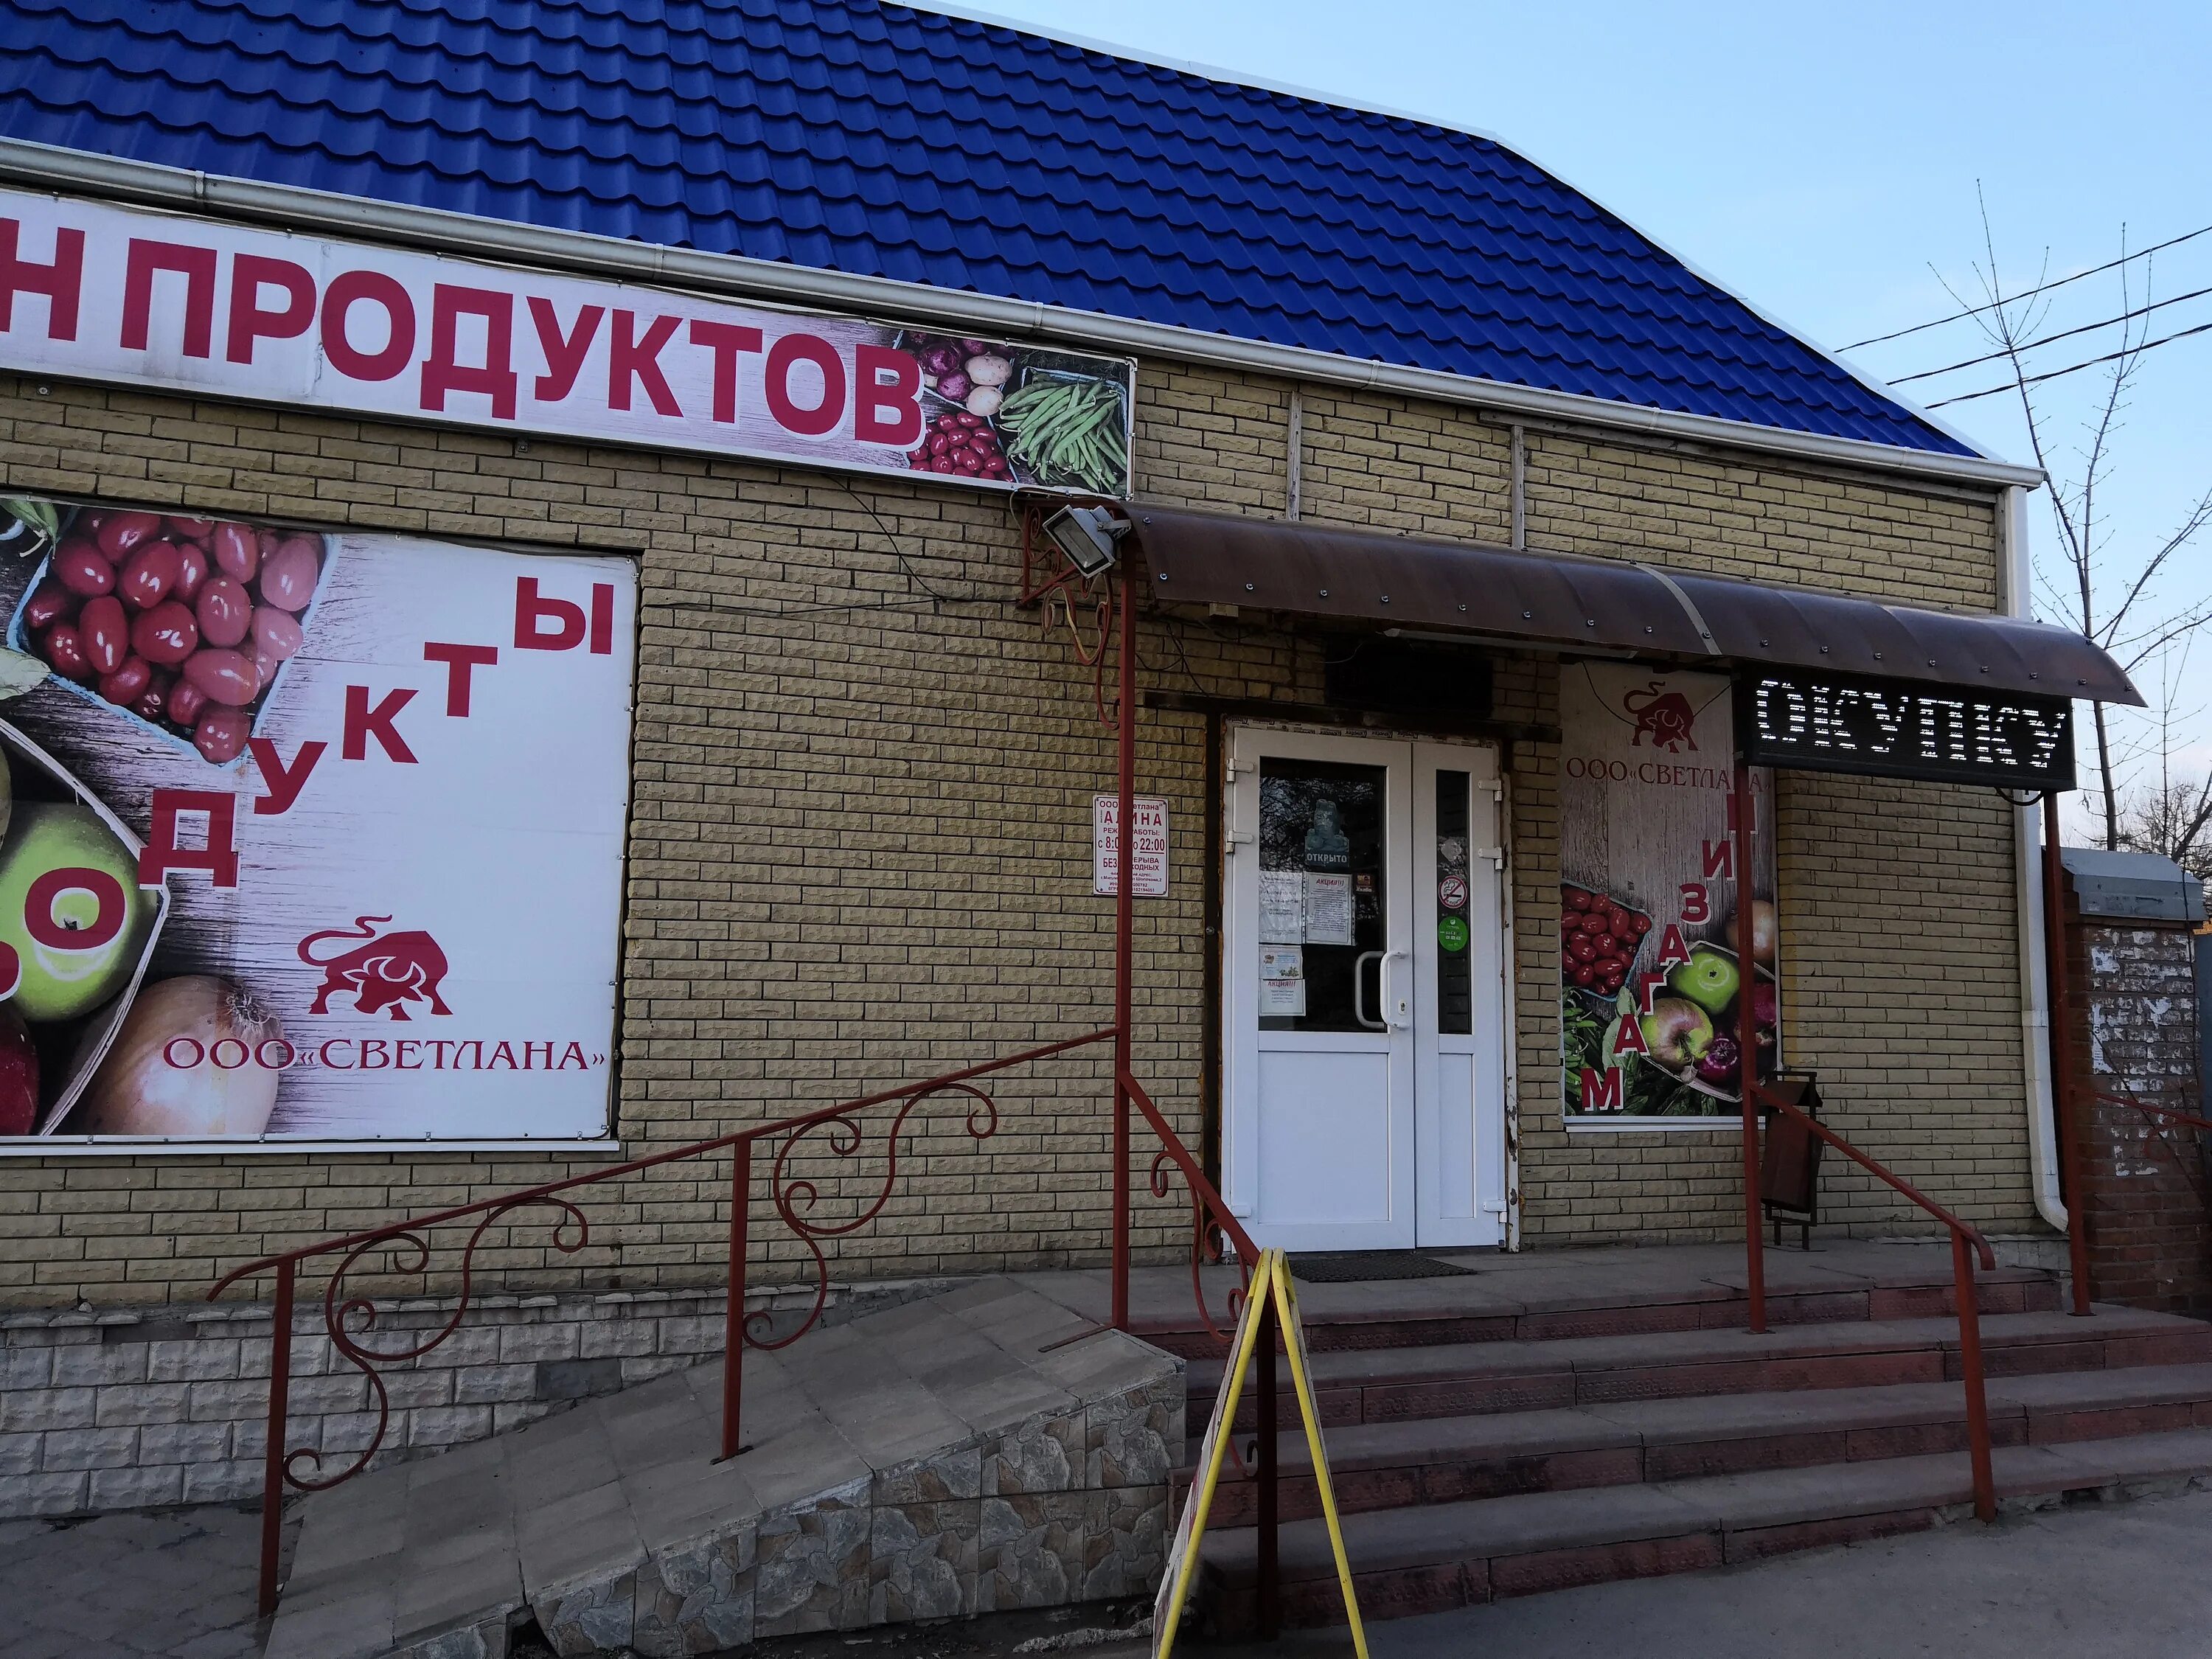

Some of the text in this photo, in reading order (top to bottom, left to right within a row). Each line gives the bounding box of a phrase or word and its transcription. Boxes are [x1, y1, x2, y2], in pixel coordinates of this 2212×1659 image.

[120, 238, 923, 446] ПРОДУКТОВ
[0, 576, 615, 1000] ОДУКТЫ
[1104, 811, 1162, 826] АИНА
[1106, 836, 1119, 849] 8:0
[1140, 838, 1165, 851] 22:00
[1103, 858, 1117, 868] БЕЗ
[1307, 853, 1347, 863] ОТКРЫТО
[1316, 878, 1344, 886] АКЦИЯ!!!
